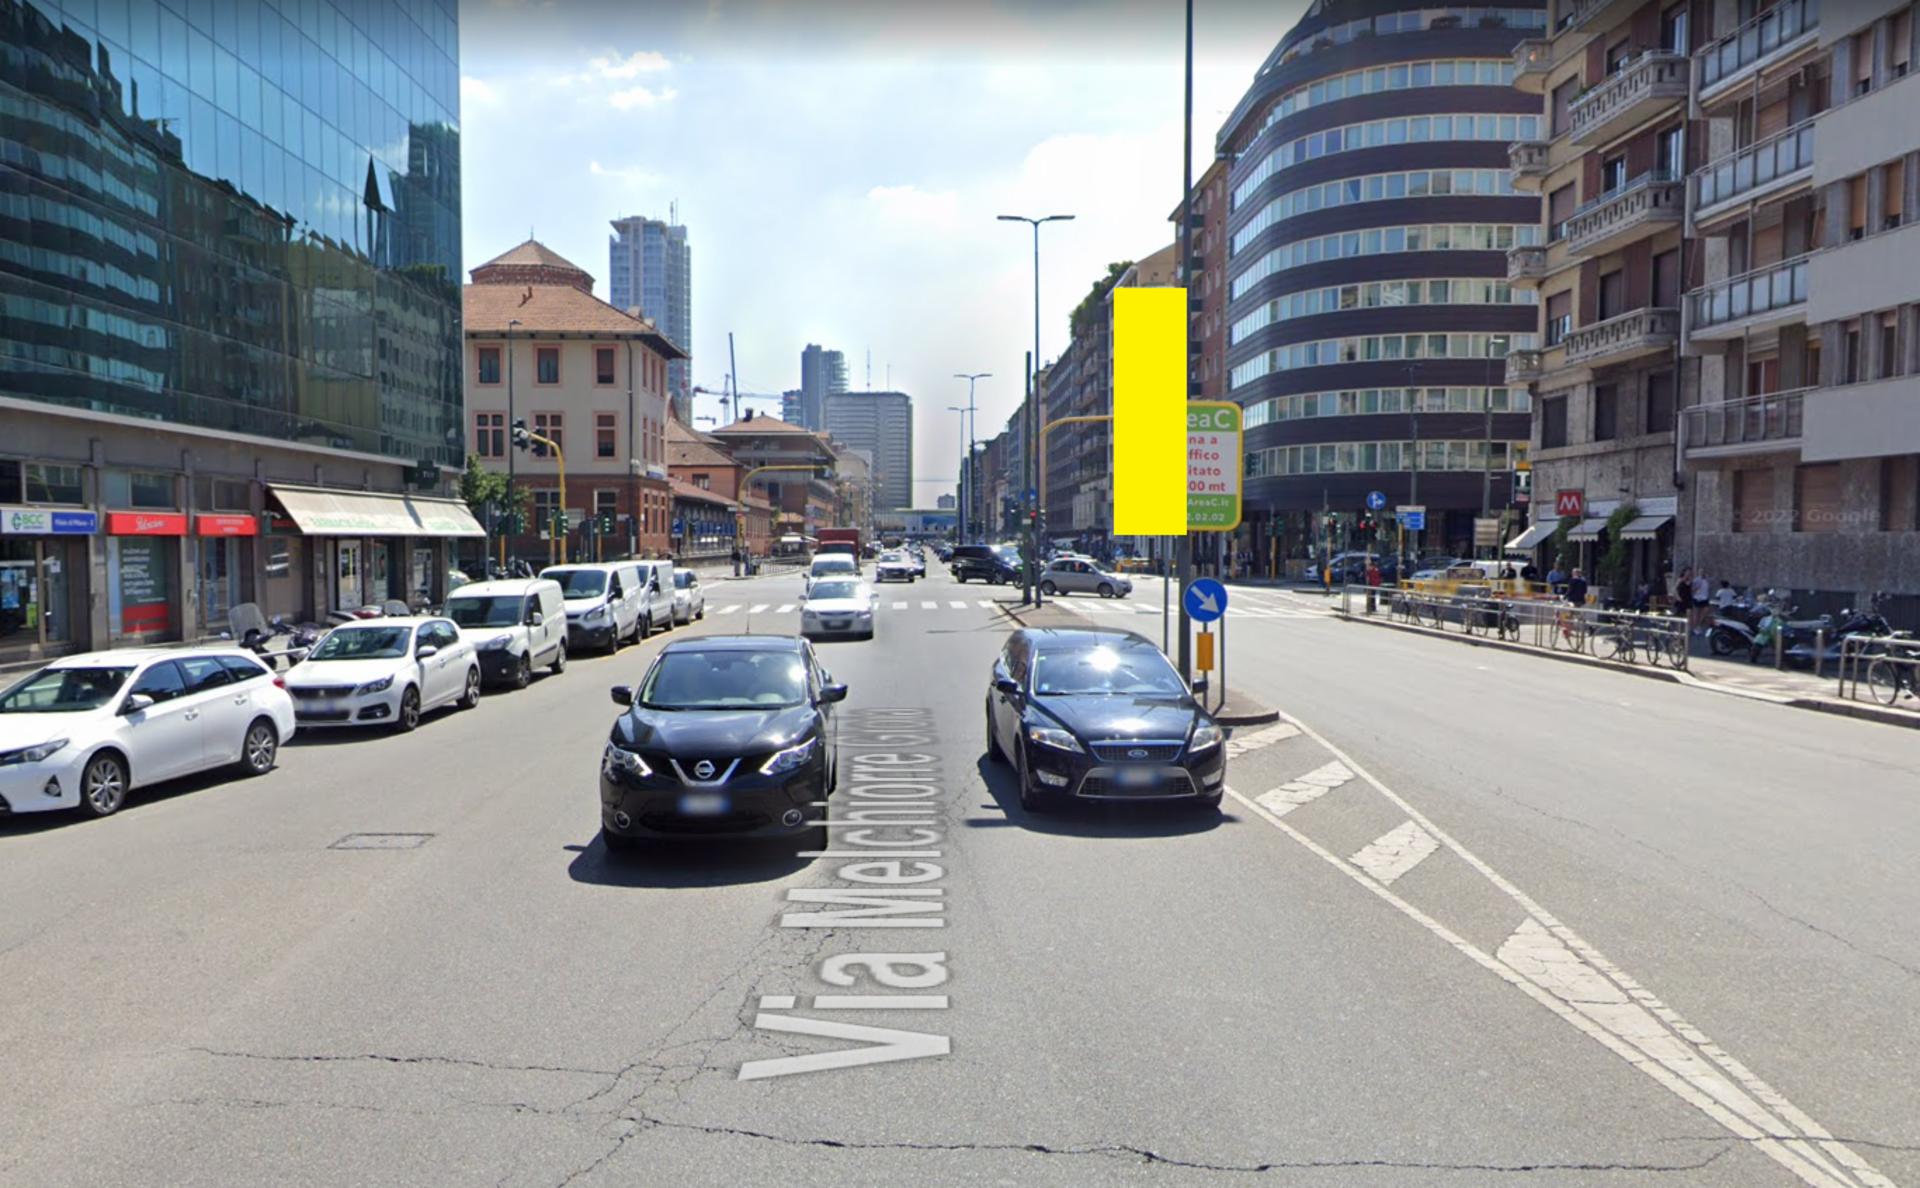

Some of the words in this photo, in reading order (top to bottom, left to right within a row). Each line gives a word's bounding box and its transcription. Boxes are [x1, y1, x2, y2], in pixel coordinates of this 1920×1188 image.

[1187, 409, 1231, 429] eaC
[1188, 436, 1205, 445] na
[1210, 436, 1218, 445] a
[1188, 448, 1220, 461] ffico
[1188, 465, 1221, 476] itato
[1188, 480, 1205, 492] 00
[1209, 481, 1226, 492] mt
[1559, 495, 1580, 511] M
